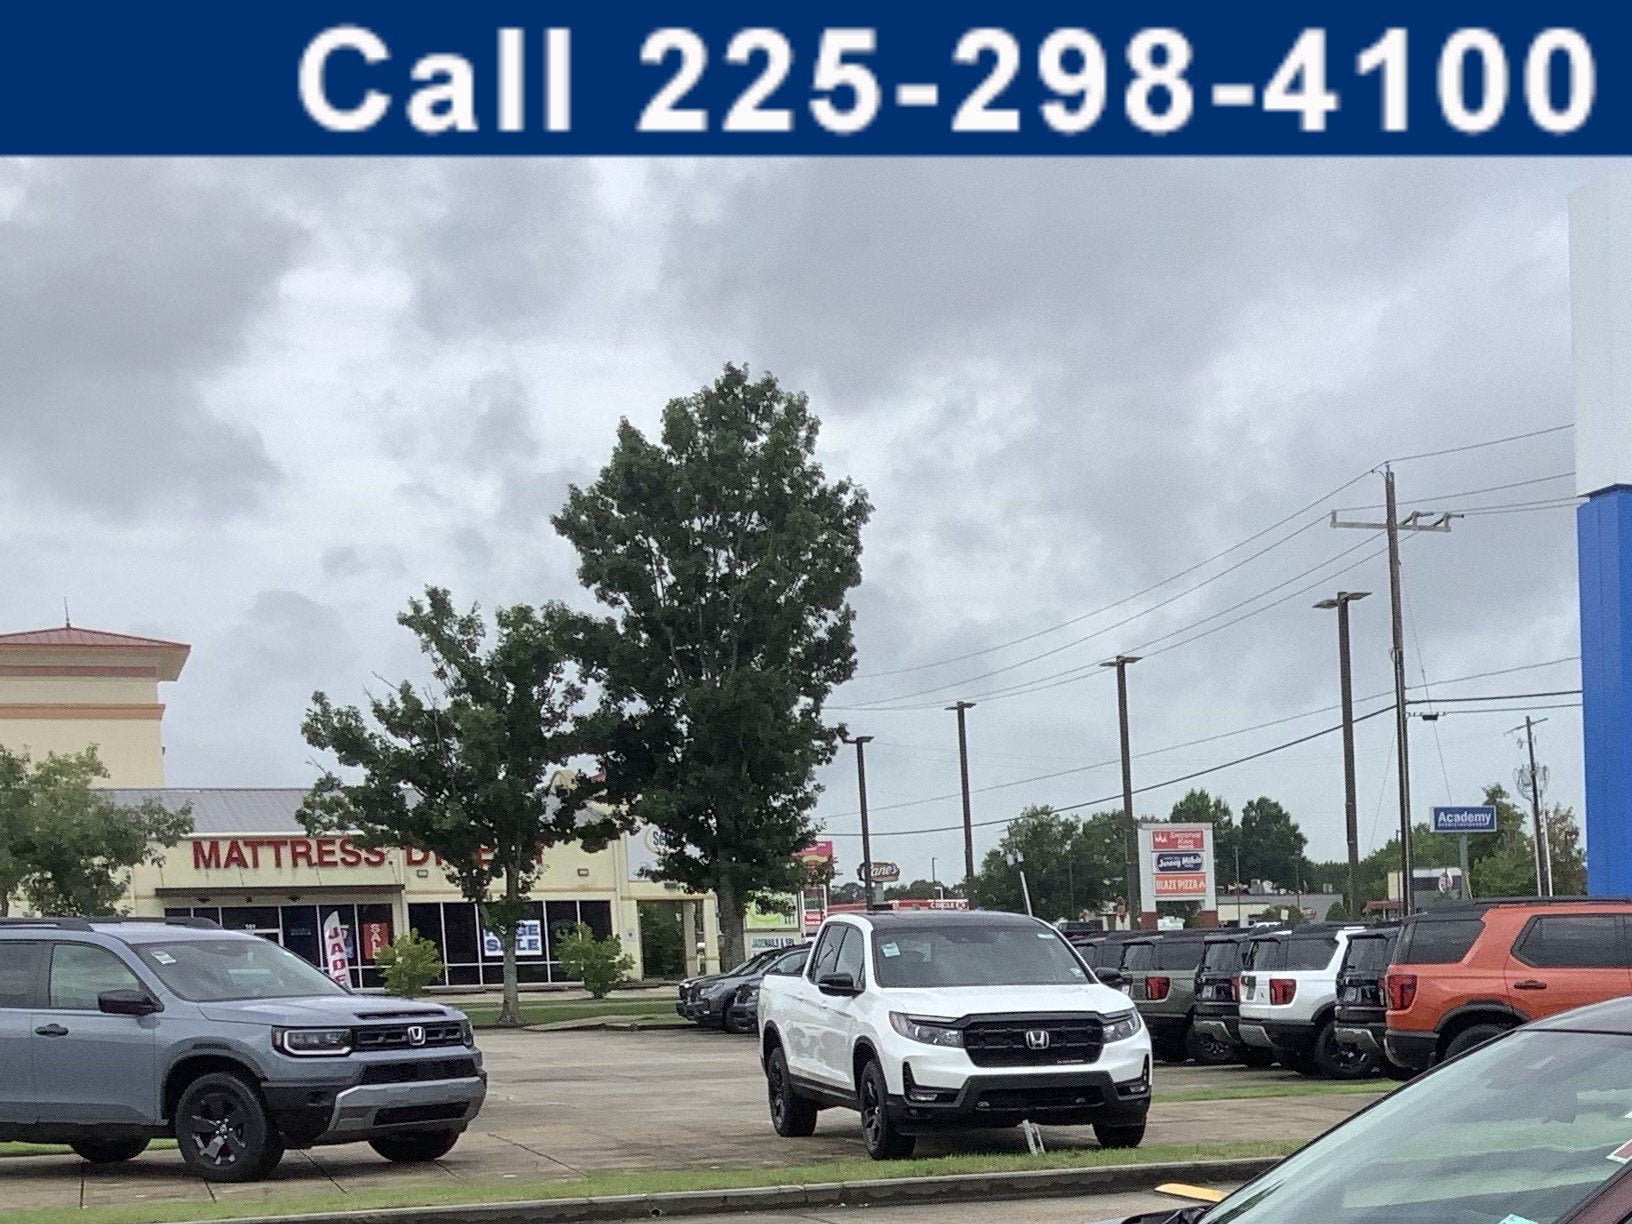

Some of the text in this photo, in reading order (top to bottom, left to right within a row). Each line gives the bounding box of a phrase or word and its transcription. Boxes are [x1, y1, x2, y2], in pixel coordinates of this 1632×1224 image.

[1437, 811, 1492, 826] Academy
[192, 837, 387, 869] MATTRESS
[369, 923, 382, 959] SAL
[485, 938, 540, 952] SLE
